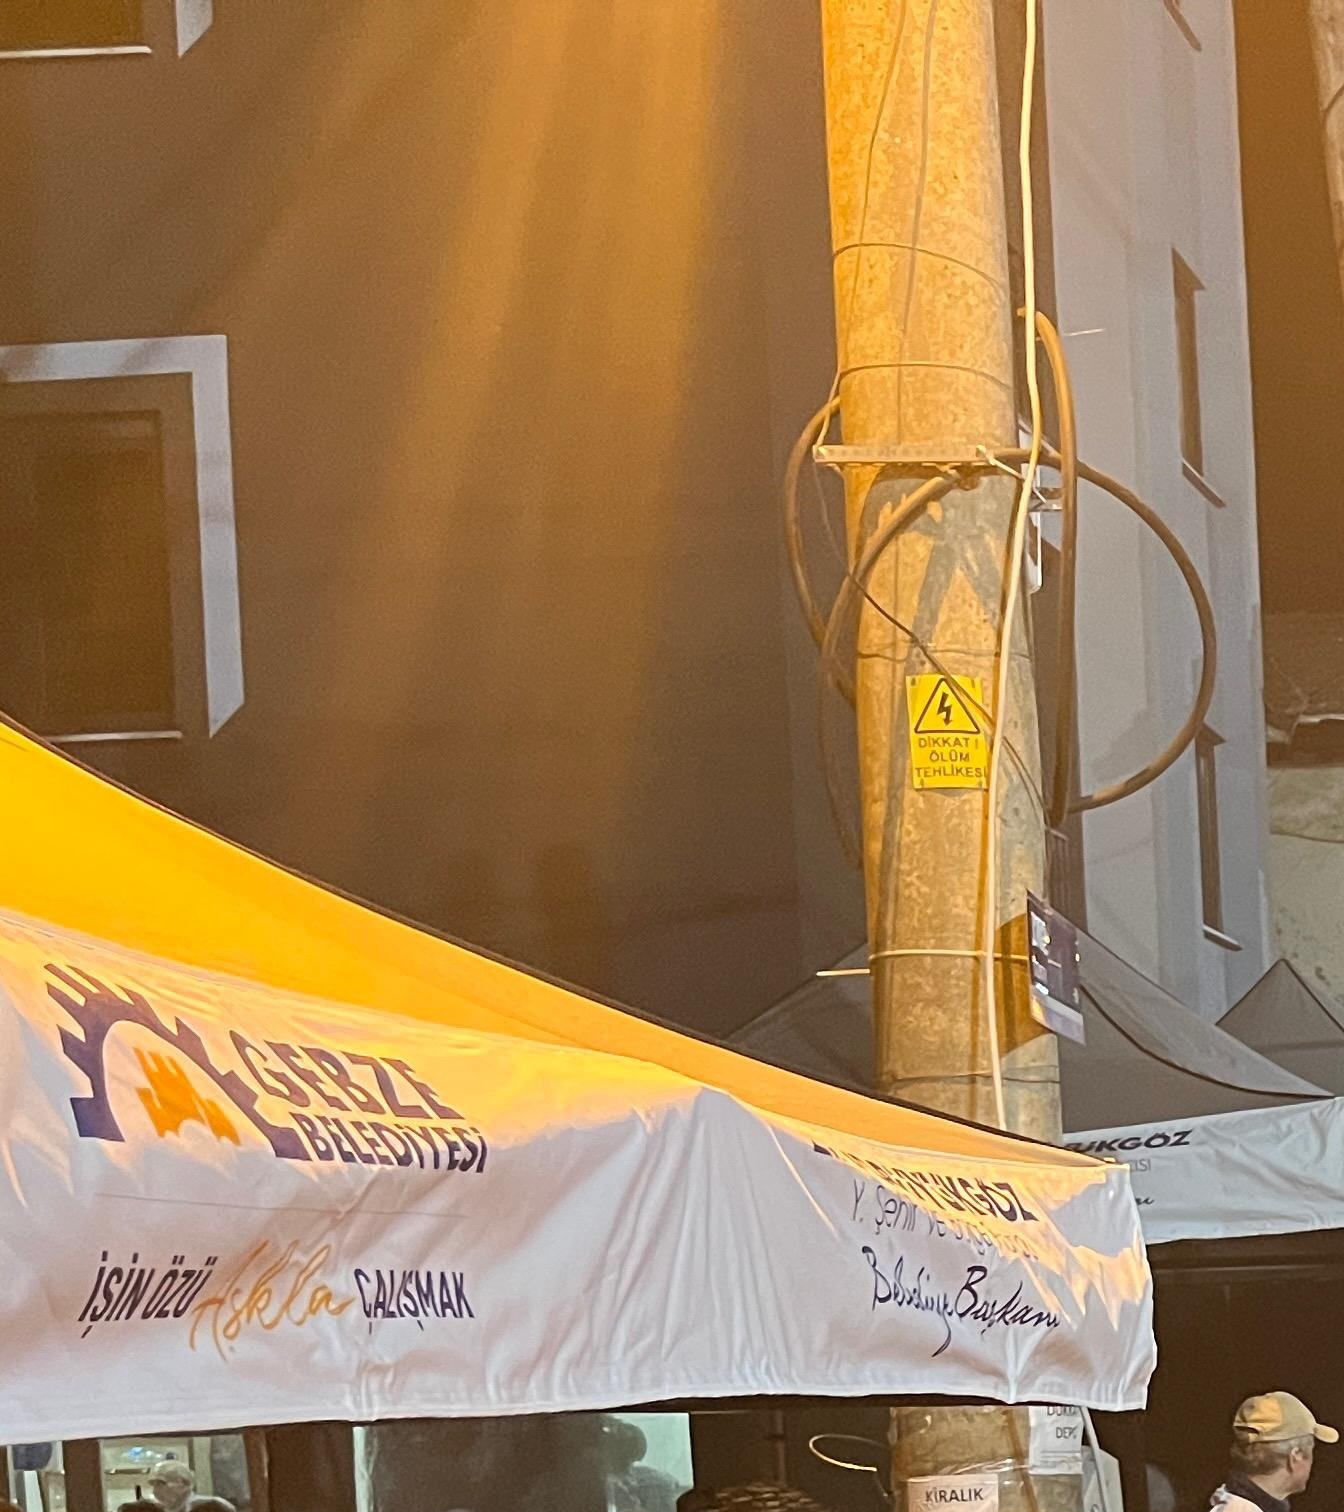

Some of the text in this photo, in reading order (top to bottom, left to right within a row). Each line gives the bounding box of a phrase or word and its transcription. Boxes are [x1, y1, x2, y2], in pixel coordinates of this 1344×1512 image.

[918, 736, 970, 748] DİKKAT
[929, 748, 970, 762] ÖLÜM
[229, 1030, 466, 1120] GEBZE
[289, 1112, 487, 1174] BELEDİYESİ
[78, 1251, 152, 1338] İŞİN
[142, 1256, 219, 1320] ÖZÜ
[353, 1268, 475, 1335] ÇALIŞMAK
